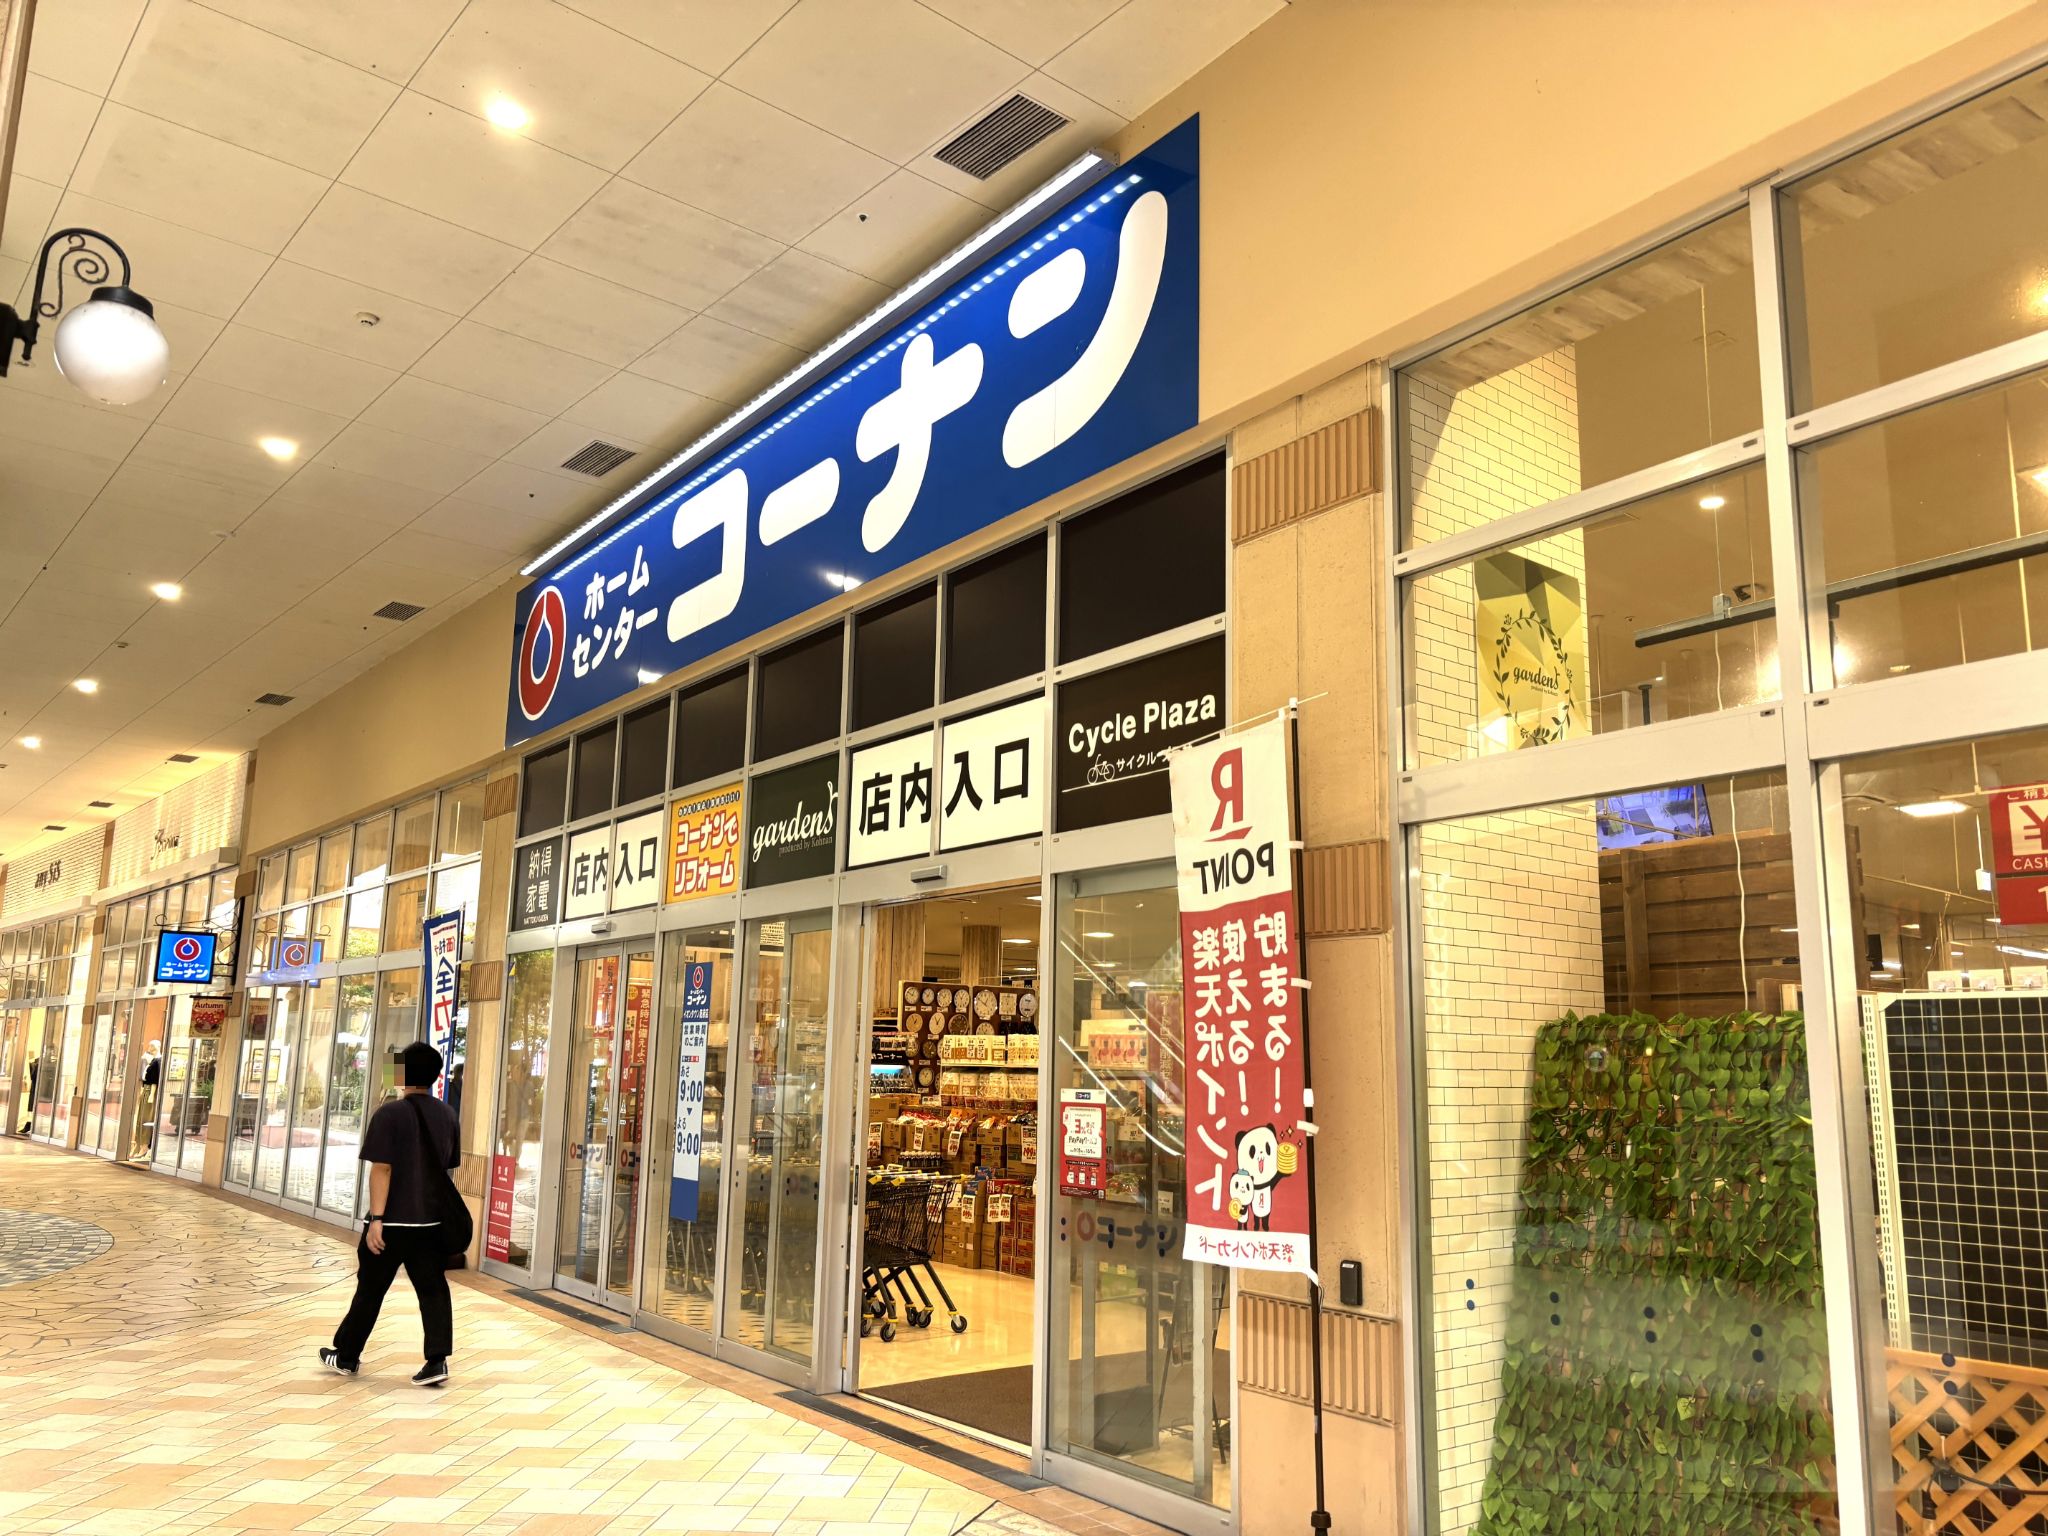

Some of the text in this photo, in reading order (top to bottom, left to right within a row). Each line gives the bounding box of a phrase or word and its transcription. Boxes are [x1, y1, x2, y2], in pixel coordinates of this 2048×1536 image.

[667, 190, 1169, 643] コーナン
[583, 544, 650, 621] ホーム
[572, 607, 659, 679] センター
[1513, 665, 1560, 690] gardens
[1068, 694, 1217, 758] Cycle Plaza
[858, 737, 1030, 837] 店内入口
[676, 809, 738, 857] コーナンで
[752, 780, 838, 863] gardens
[811, 835, 833, 848] Kohnan
[528, 845, 552, 880] 納得
[571, 836, 658, 897] 店内入口
[674, 848, 735, 896] リフォーム
[526, 880, 550, 913] 家電
[160, 967, 209, 979] コーナン
[686, 994, 707, 1006] コーナン
[684, 1024, 706, 1035] 営業時間
[684, 1036, 704, 1047] のご案内
[680, 1066, 690, 1078] あさ
[680, 1080, 703, 1103] 9:00
[676, 1117, 687, 1130] よる
[676, 1131, 700, 1156] 9:00
[1097, 1216, 1178, 1251] コーナン
